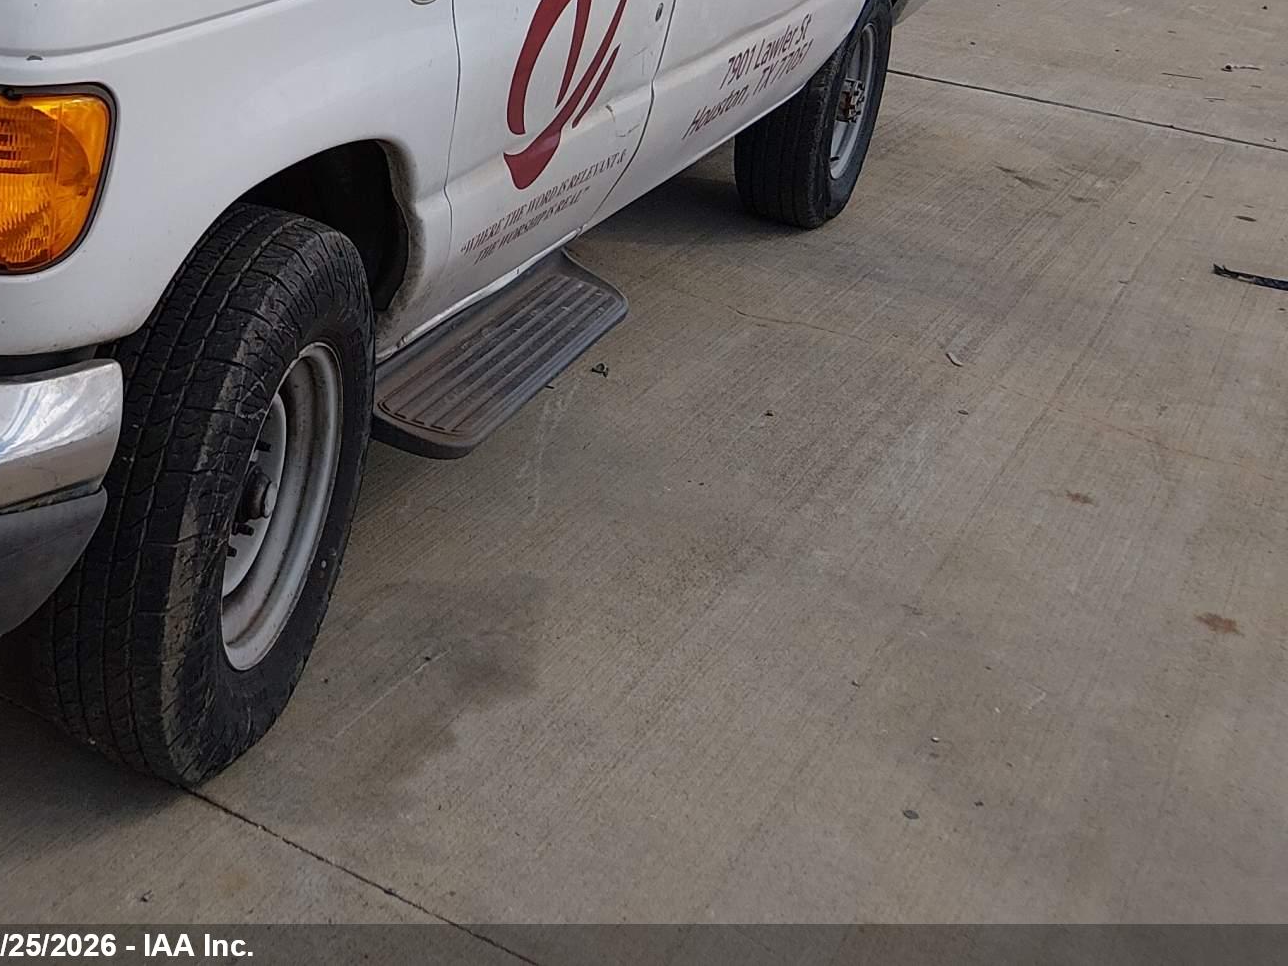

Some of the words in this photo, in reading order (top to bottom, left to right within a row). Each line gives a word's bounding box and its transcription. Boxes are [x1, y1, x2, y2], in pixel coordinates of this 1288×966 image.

[682, 84, 750, 140] Houston,
[753, 60, 780, 96] TX
[770, 38, 814, 85] 77051
[719, 44, 757, 90] 7901
[753, 24, 799, 70] Lawler
[795, 13, 812, 45] St
[503, 203, 528, 229] THE
[527, 187, 562, 214] WORD
[556, 181, 571, 197] IS
[568, 151, 622, 192] RELEVANT
[474, 240, 501, 266] THE
